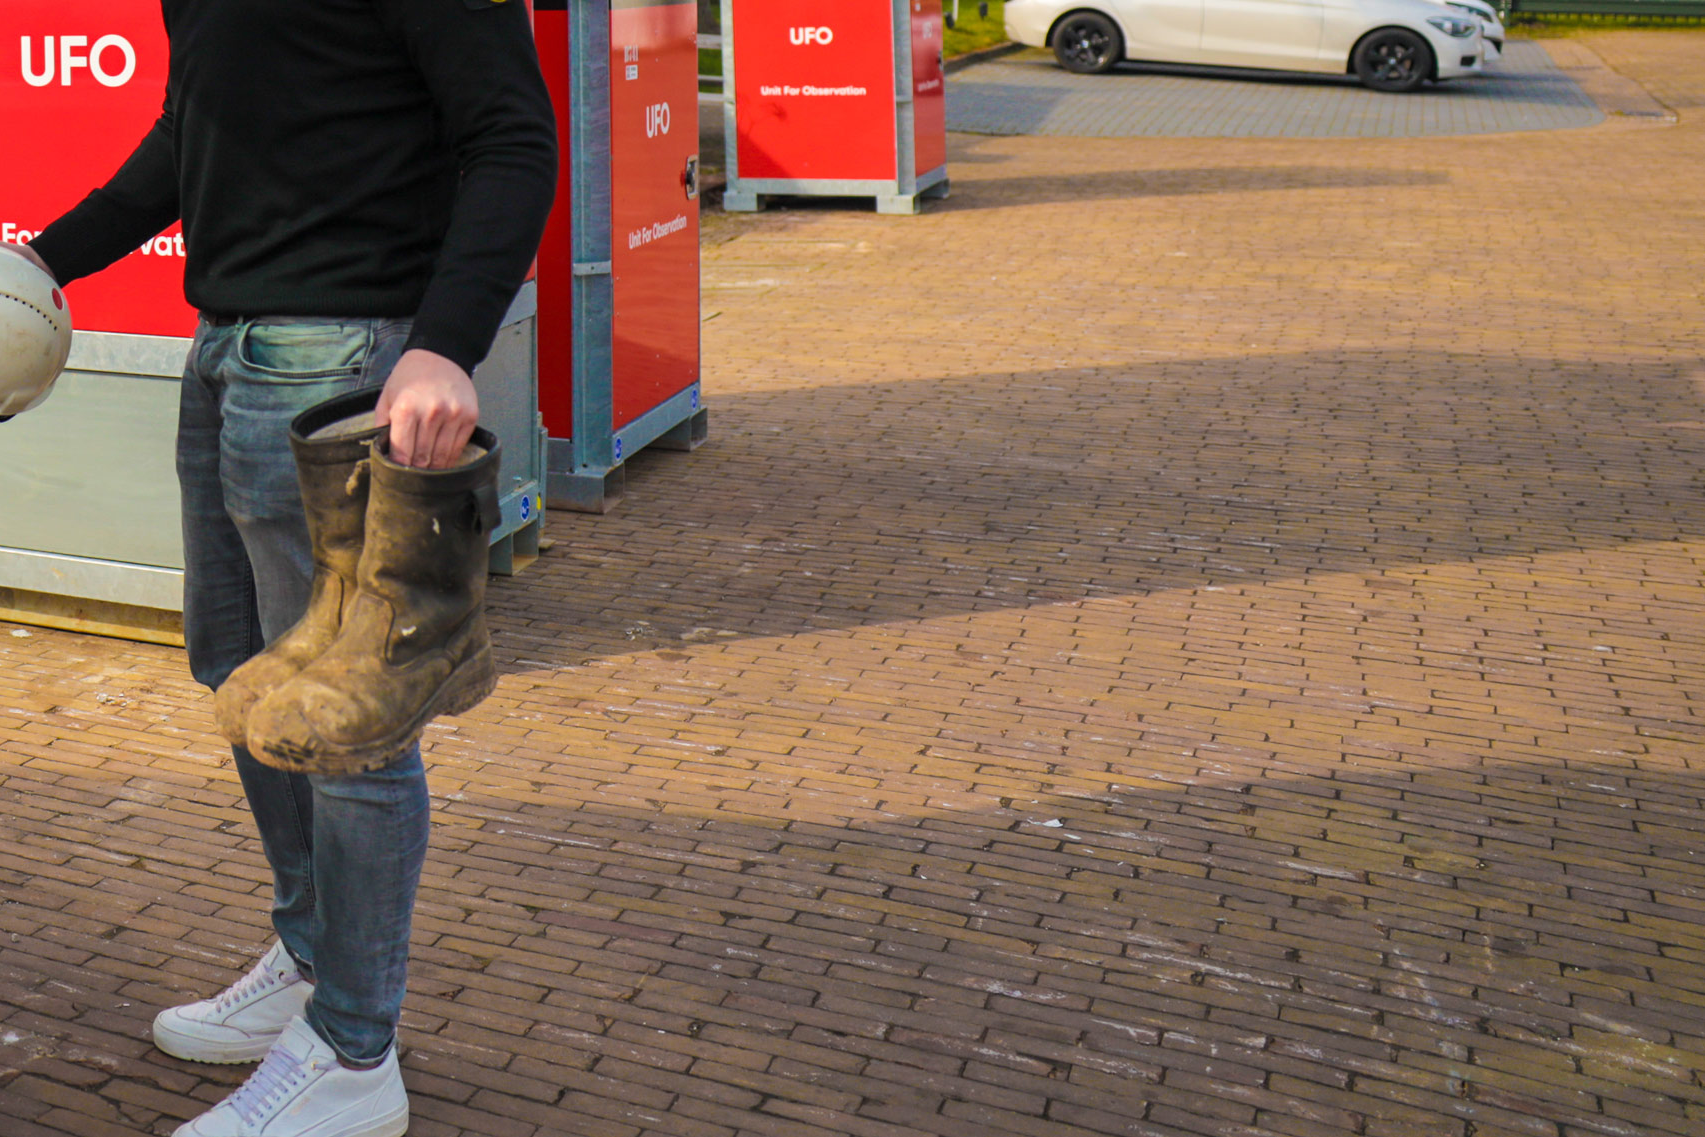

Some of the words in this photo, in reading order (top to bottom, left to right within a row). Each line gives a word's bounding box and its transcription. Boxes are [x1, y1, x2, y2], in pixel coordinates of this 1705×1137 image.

[789, 26, 834, 45] UFO
[21, 34, 136, 87] UFO
[760, 85, 782, 96] Unit
[783, 85, 800, 96] For
[801, 85, 867, 96] Observation
[646, 102, 671, 138] UFO
[628, 229, 642, 250] Unit
[642, 226, 652, 245] For
[653, 213, 687, 240] Observation
